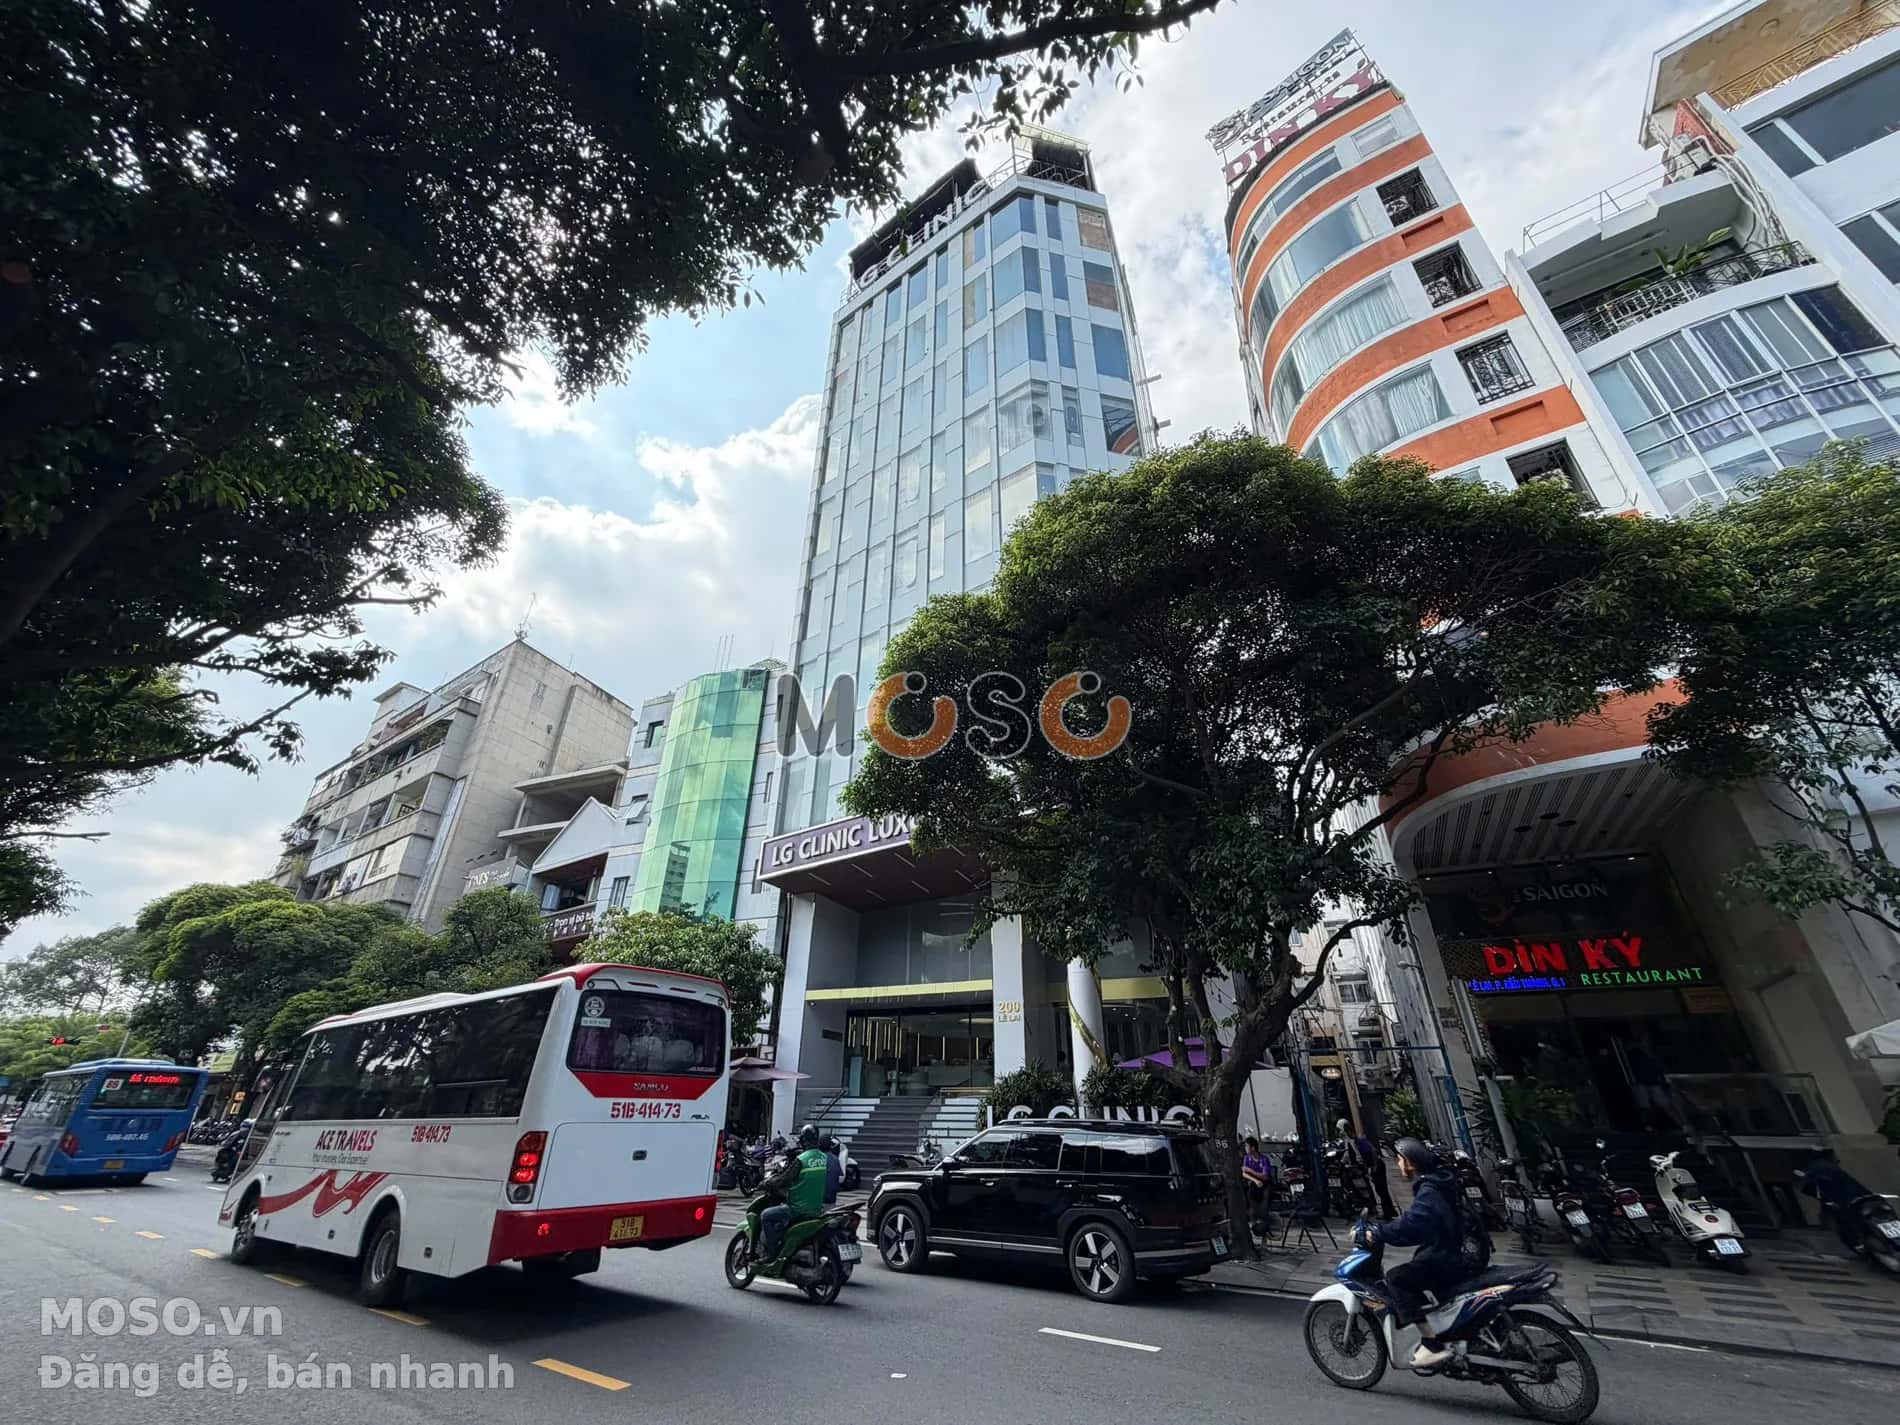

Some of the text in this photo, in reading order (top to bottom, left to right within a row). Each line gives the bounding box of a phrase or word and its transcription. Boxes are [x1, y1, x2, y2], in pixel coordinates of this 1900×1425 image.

[771, 842, 794, 867] LG
[799, 823, 864, 860] CLINIC
[1522, 882, 1609, 902] SAIGON
[1581, 967, 1704, 986] RESTAURANT
[998, 1001, 1021, 1013] 200
[315, 1130, 378, 1151] ACE TRAVELS
